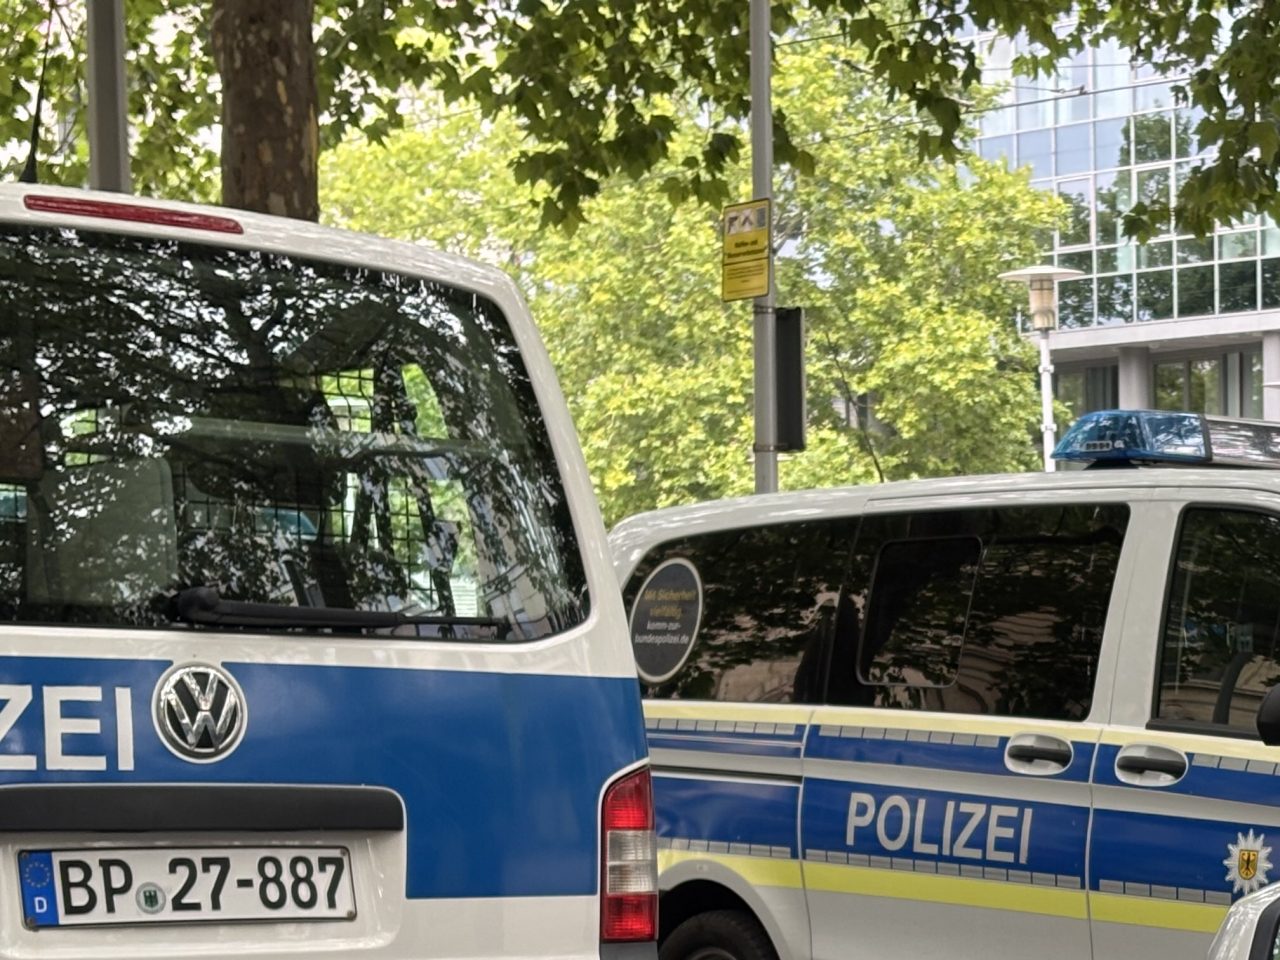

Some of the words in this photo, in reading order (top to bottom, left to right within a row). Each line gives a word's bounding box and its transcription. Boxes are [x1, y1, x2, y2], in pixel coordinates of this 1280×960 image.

[846, 791, 1033, 865] POLIZEI
[34, 896, 48, 914] D
[59, 858, 133, 916] BP
[167, 855, 346, 912] 27-887
